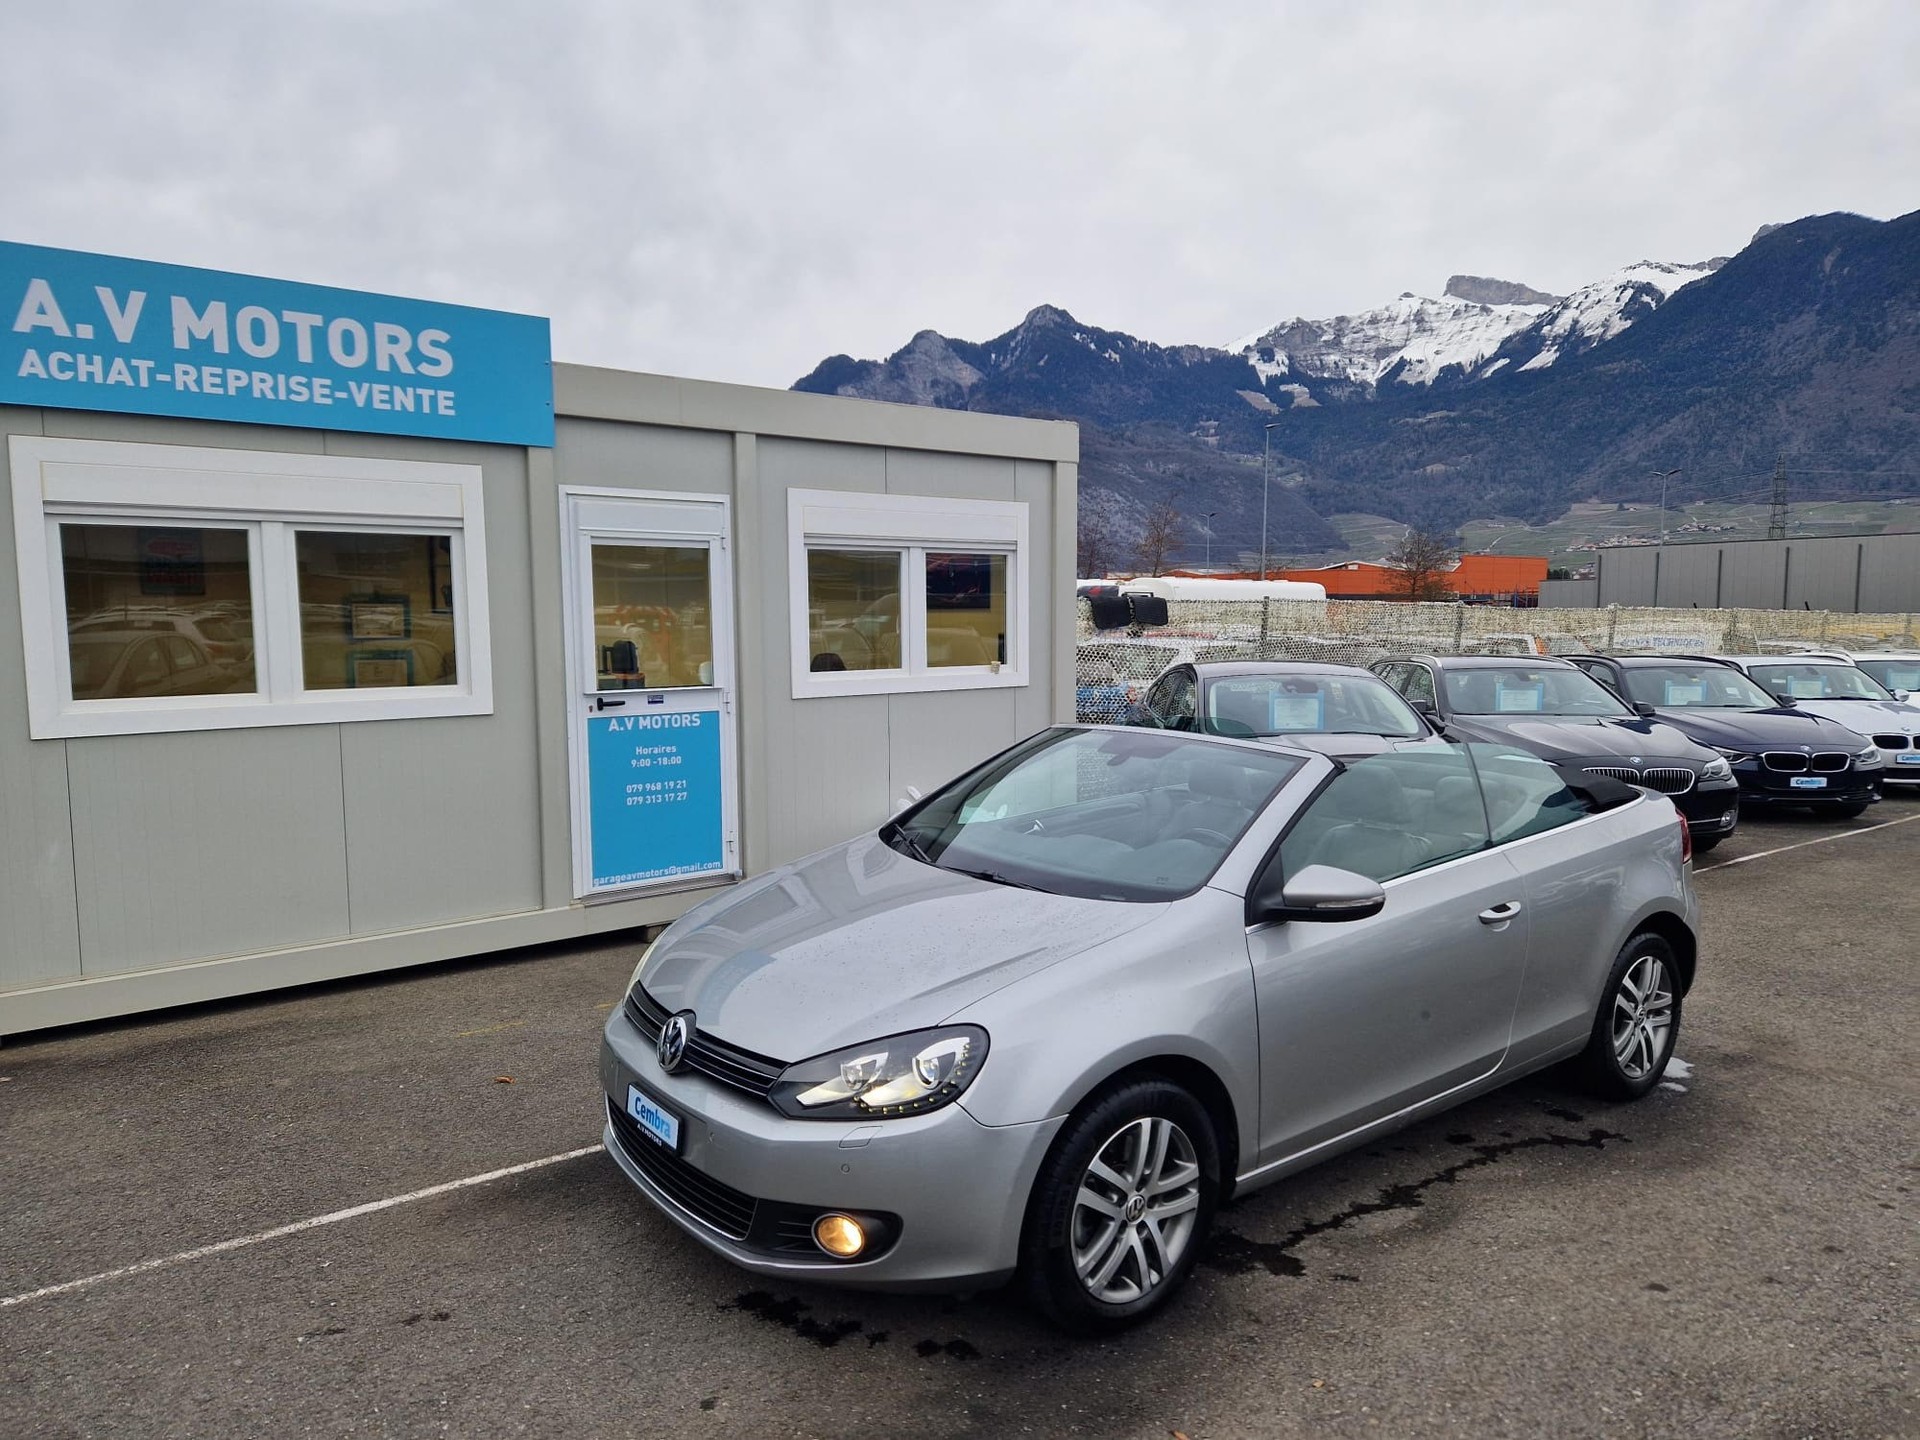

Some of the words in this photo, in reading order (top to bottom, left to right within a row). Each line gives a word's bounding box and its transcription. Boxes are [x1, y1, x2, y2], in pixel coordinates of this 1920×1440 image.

[13, 278, 147, 343] A.V
[171, 296, 454, 377] MOTORS
[18, 349, 456, 416] ACHAT-REPRISE-VENTE
[608, 718, 634, 732] A.V
[639, 714, 700, 729] MOTORS
[635, 745, 677, 755] Horaires
[631, 758, 651, 768] 9:00
[626, 784, 643, 793] 079
[645, 782, 662, 792] 968
[664, 781, 675, 790] 19
[676, 780, 687, 789] 21
[626, 796, 644, 806] 079
[645, 794, 662, 804] 313
[664, 793, 675, 802] 17
[676, 791, 688, 801] 27
[594, 861, 720, 886] garageavmotors@gmail.com
[635, 1097, 671, 1138] Cembra
